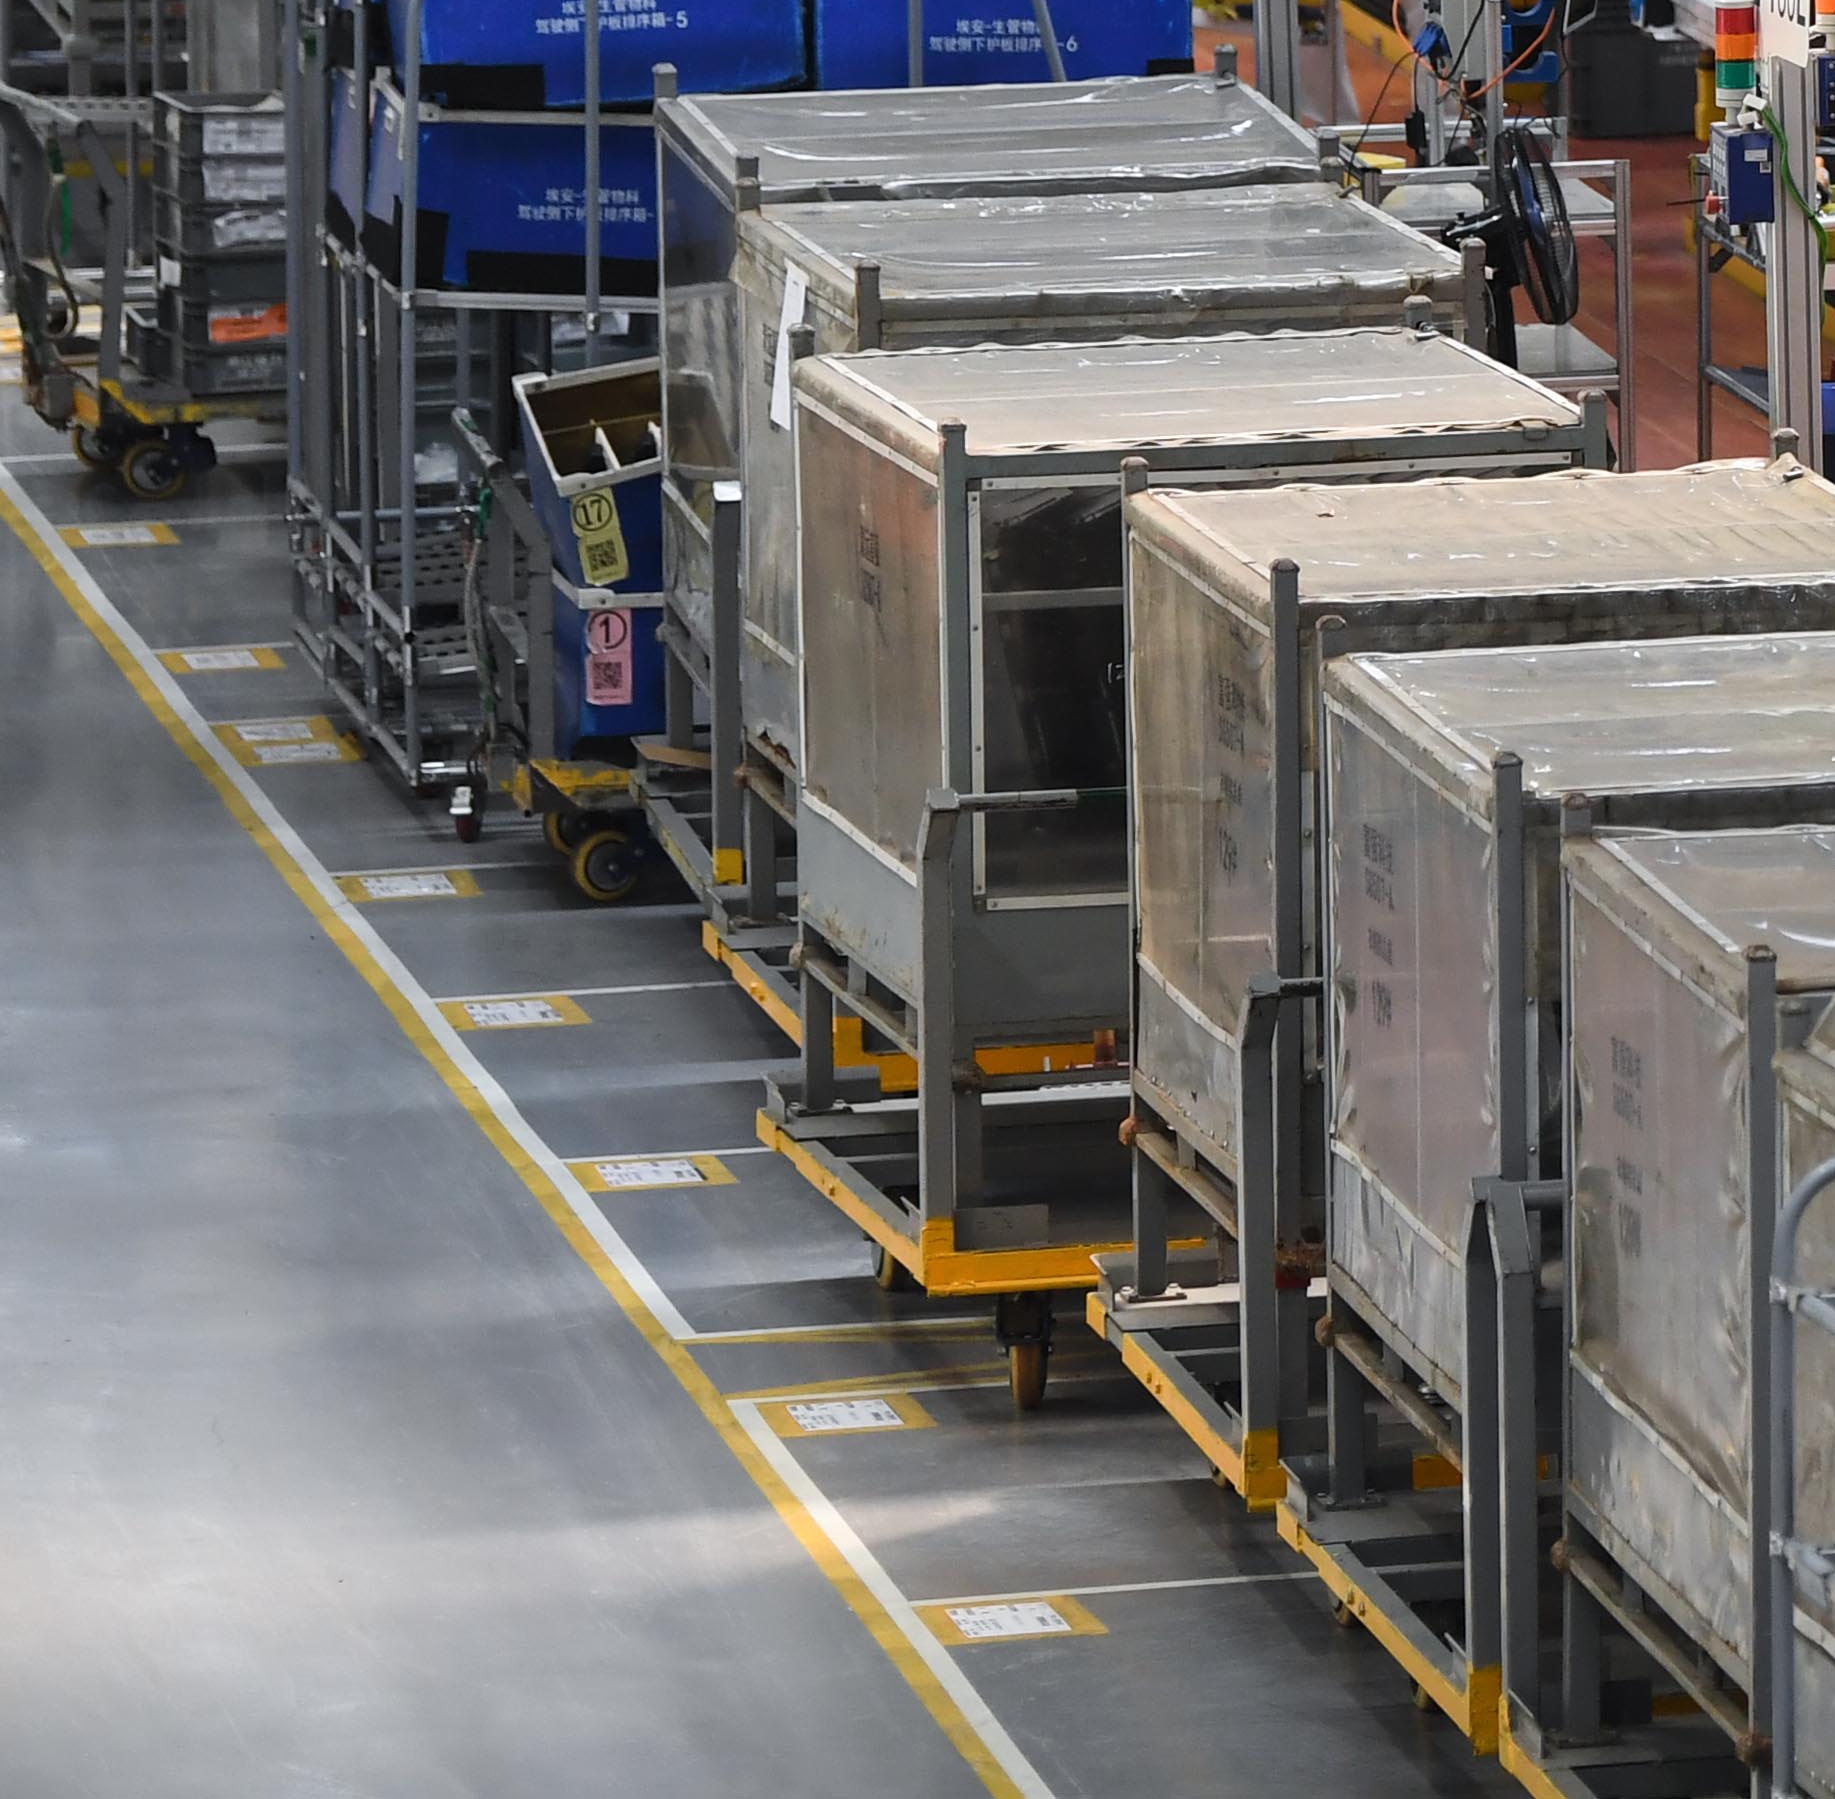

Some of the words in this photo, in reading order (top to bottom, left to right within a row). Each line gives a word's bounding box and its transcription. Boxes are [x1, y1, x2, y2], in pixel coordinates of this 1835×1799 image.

[956, 18, 1042, 35] 埃安-生管物
[929, 35, 1078, 53] 驾驶侧下护板排序-6
[578, 500, 603, 526] 17
